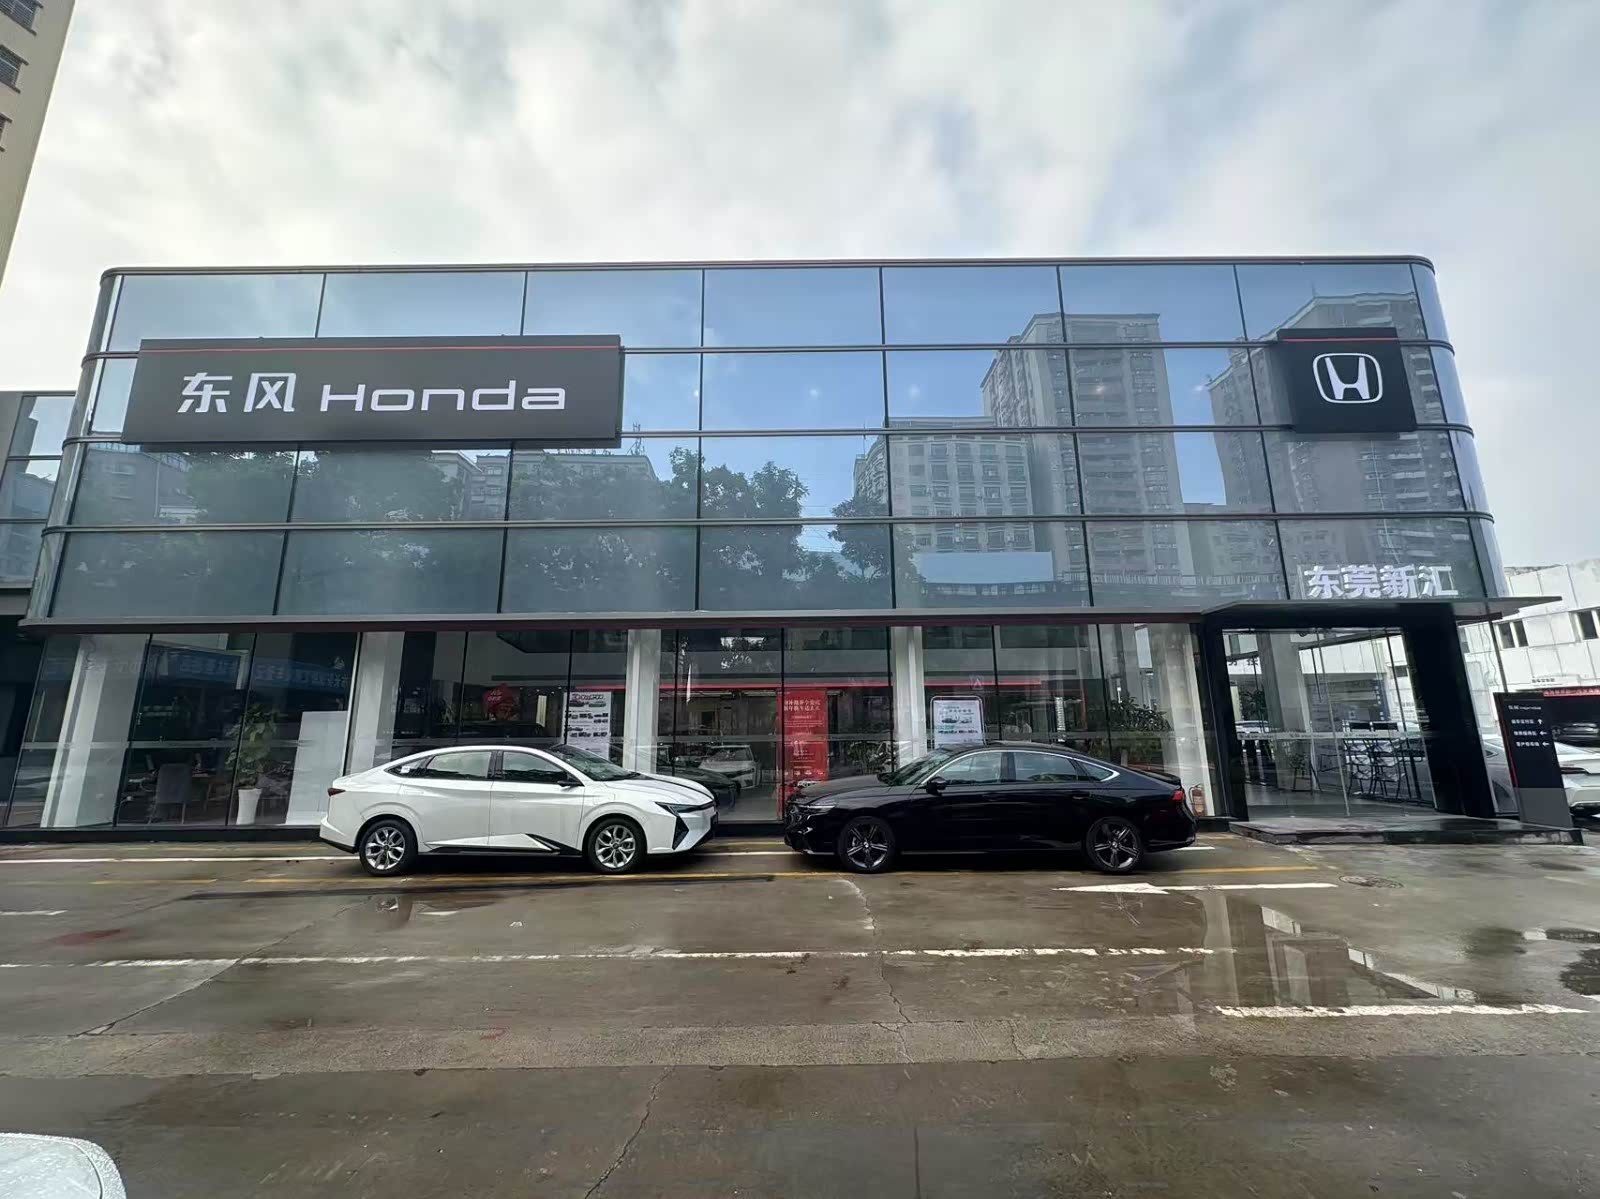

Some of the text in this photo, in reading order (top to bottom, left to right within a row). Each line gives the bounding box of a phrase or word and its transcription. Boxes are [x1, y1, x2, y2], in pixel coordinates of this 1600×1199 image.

[177, 372, 566, 413] 东风 Honda
[1304, 564, 1459, 599] 东莞新汇
